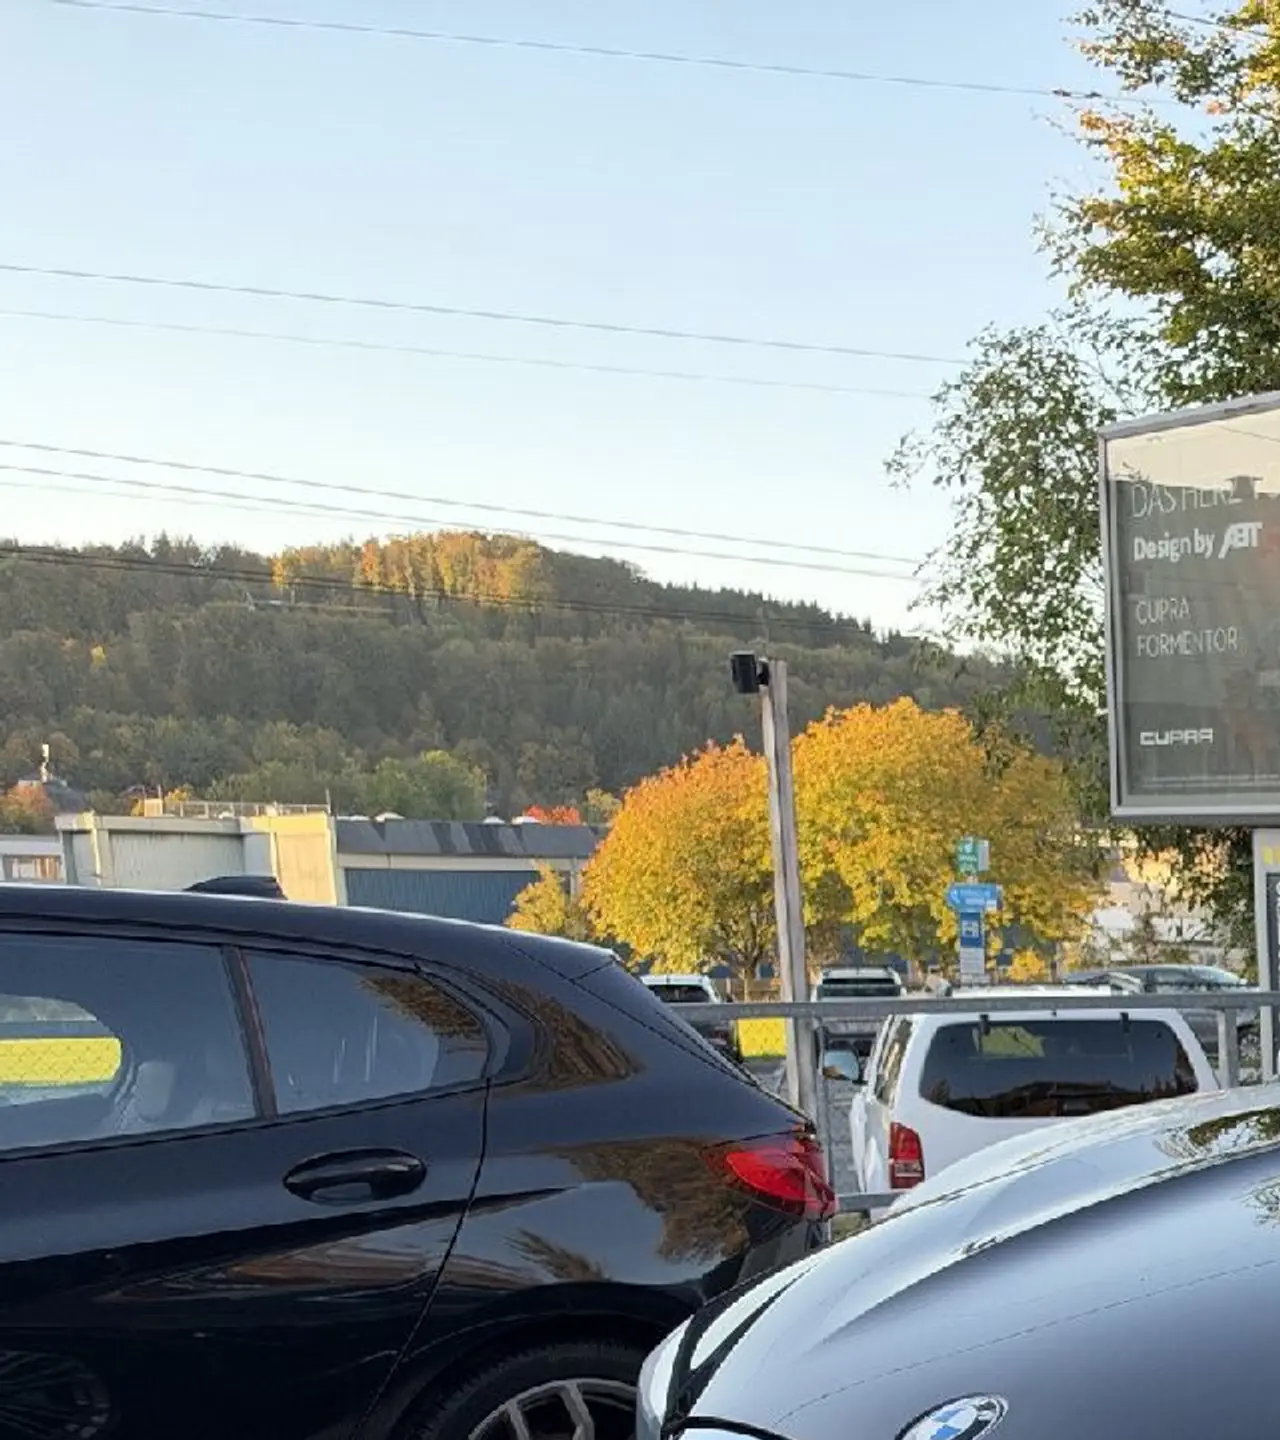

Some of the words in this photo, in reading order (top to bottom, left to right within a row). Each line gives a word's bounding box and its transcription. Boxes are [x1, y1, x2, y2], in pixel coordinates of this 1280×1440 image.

[1133, 531, 1191, 562] Design
[1195, 527, 1216, 559] by
[1217, 521, 1264, 559] ABT
[1136, 597, 1190, 625] CUPRA
[1136, 626, 1238, 658] FORMENTOR
[1140, 727, 1214, 746] CUPRA
